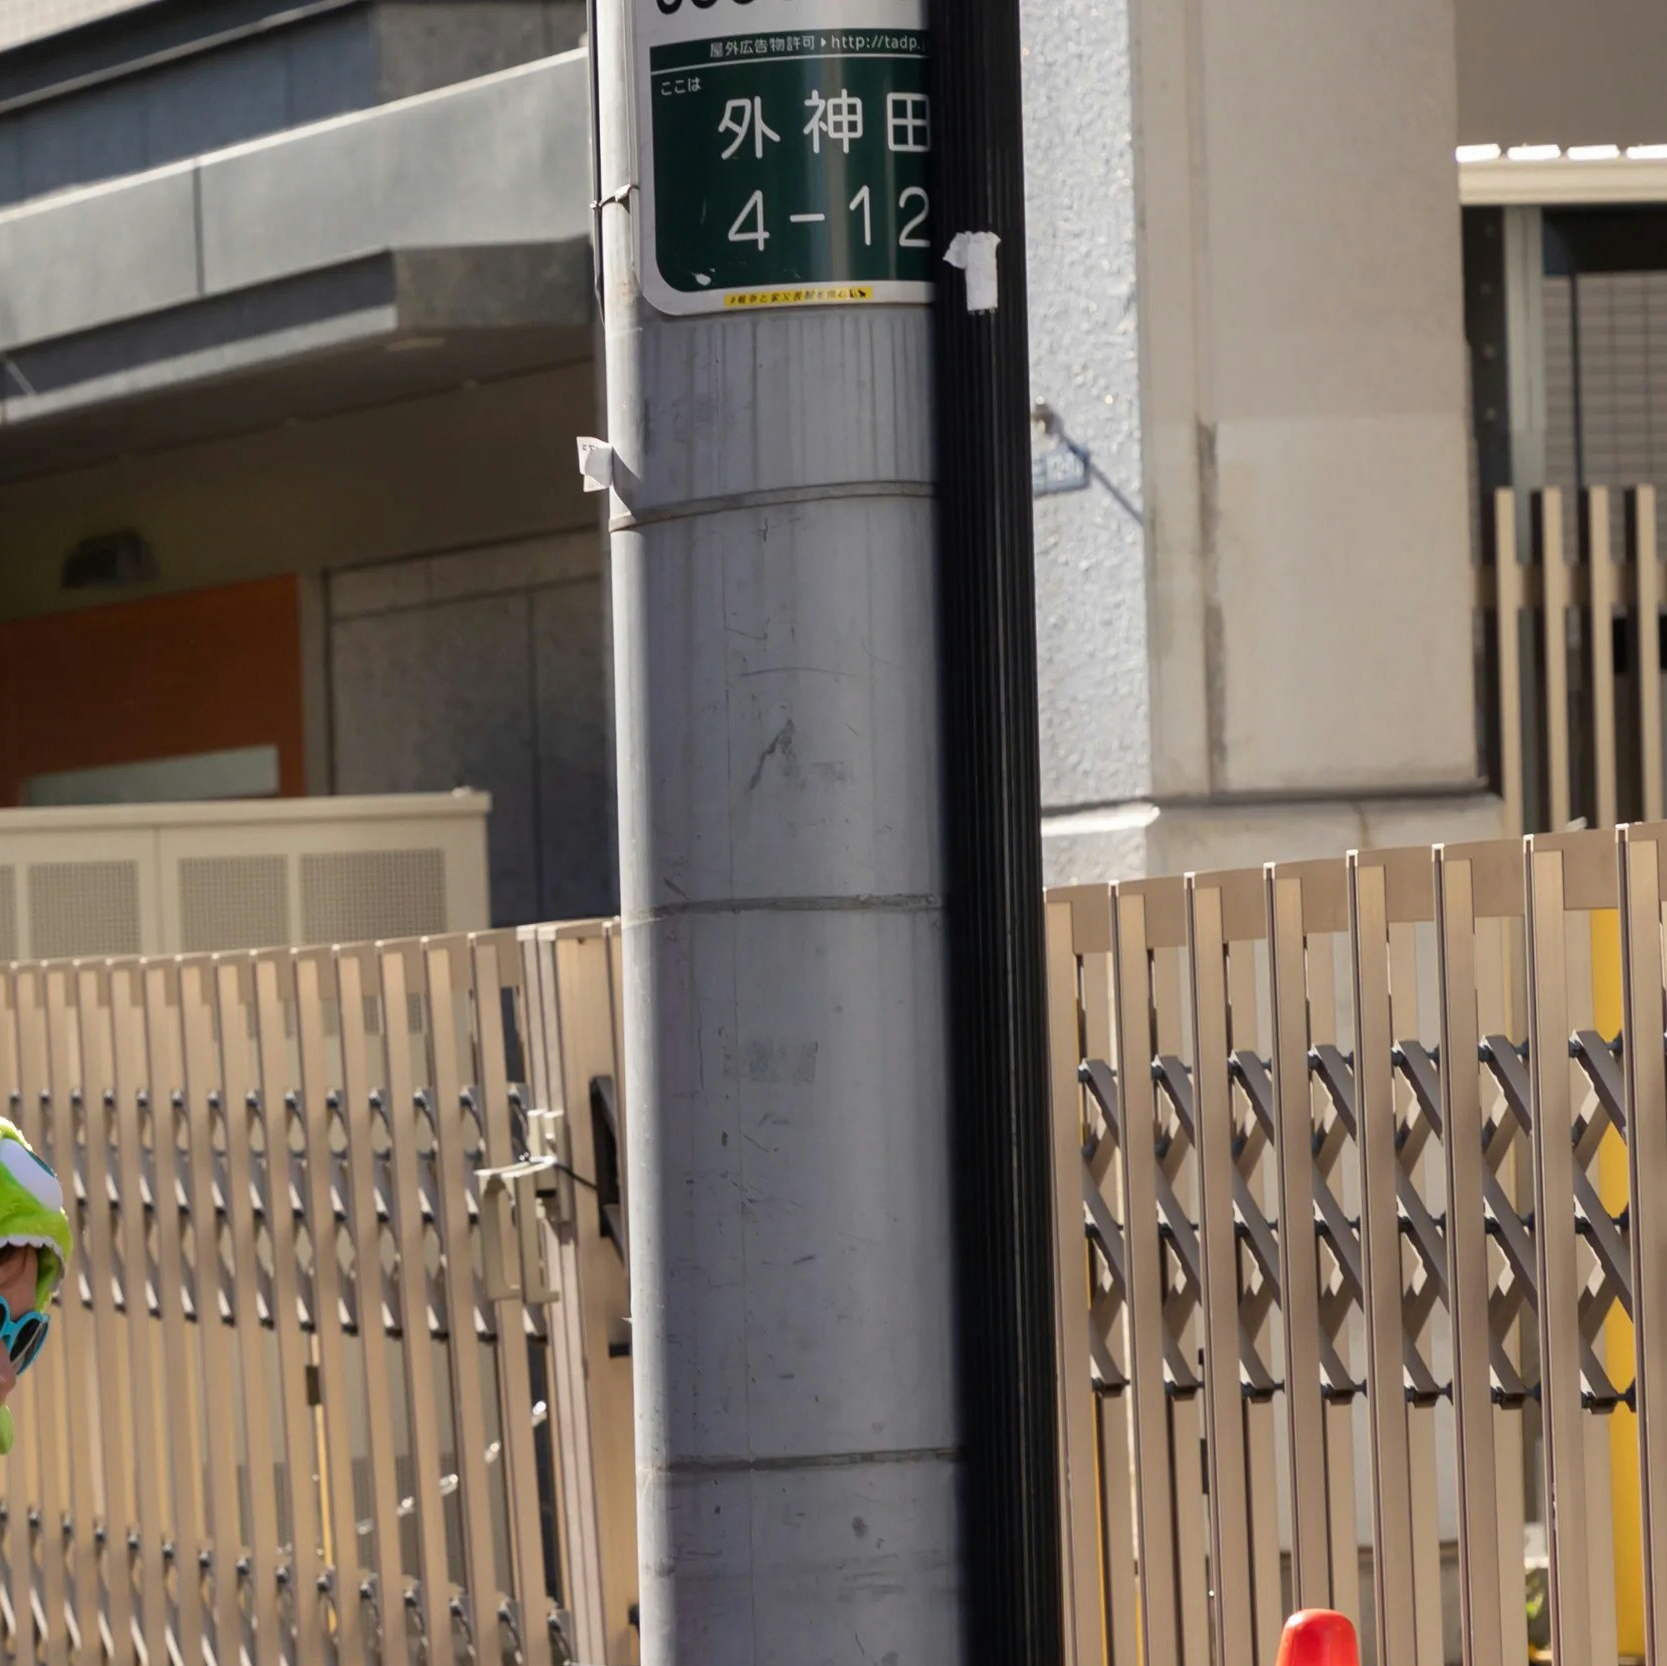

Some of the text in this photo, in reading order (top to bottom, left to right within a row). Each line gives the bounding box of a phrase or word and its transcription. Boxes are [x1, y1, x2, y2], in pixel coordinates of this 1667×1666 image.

[710, 34, 816, 58] 屋外広告物許可
[660, 76, 702, 96] ここは
[718, 88, 931, 160] 外神田
